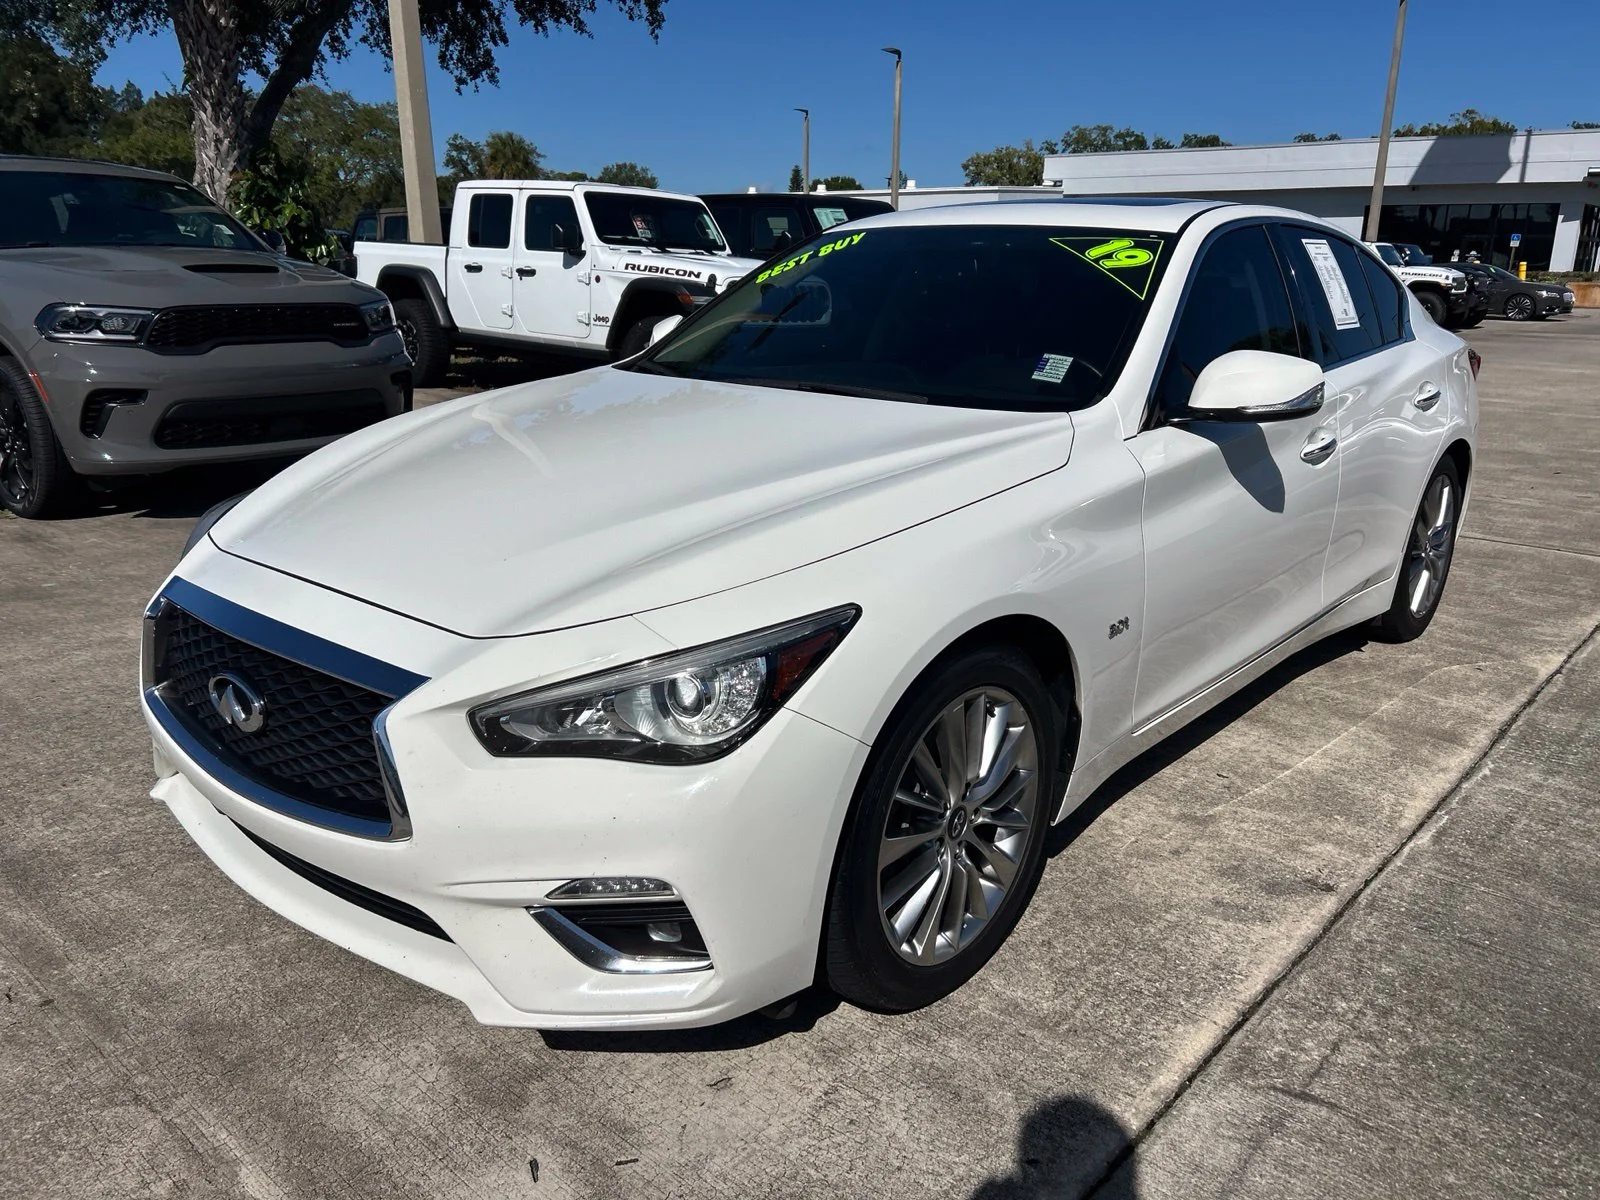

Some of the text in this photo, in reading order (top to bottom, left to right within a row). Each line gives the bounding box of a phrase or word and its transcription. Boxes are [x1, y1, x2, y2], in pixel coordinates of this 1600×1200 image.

[755, 232, 867, 284] BEST BUY
[1085, 239, 1154, 269] 19
[624, 262, 702, 279] RUBICON
[592, 313, 610, 324] Jeep
